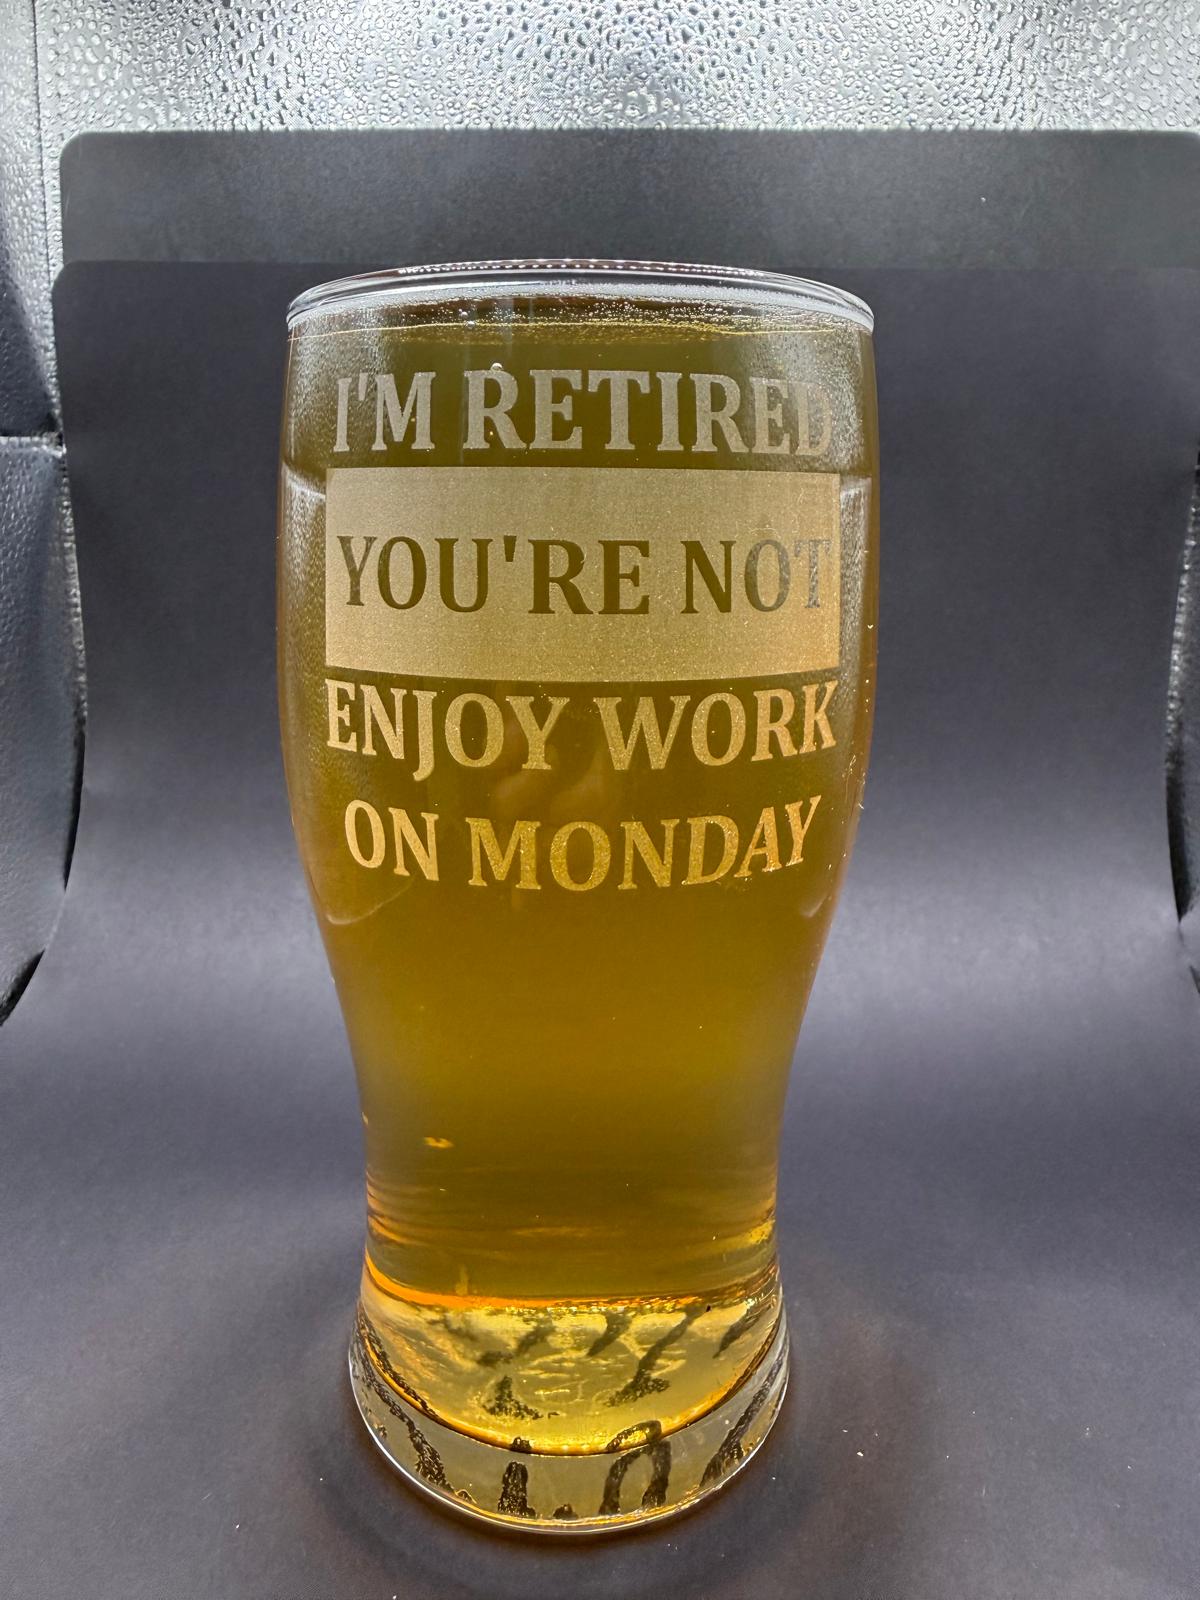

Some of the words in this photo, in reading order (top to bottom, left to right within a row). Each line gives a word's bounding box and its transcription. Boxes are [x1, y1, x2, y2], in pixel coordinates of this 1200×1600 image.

[332, 371, 436, 453] I'M
[463, 368, 833, 456] RETIRED
[336, 535, 650, 615] YOU'RE
[681, 538, 831, 615] NOT
[325, 678, 570, 781] ENJOY
[593, 680, 838, 770] WORK
[344, 799, 439, 882] ON
[465, 795, 822, 891] MONDAY
